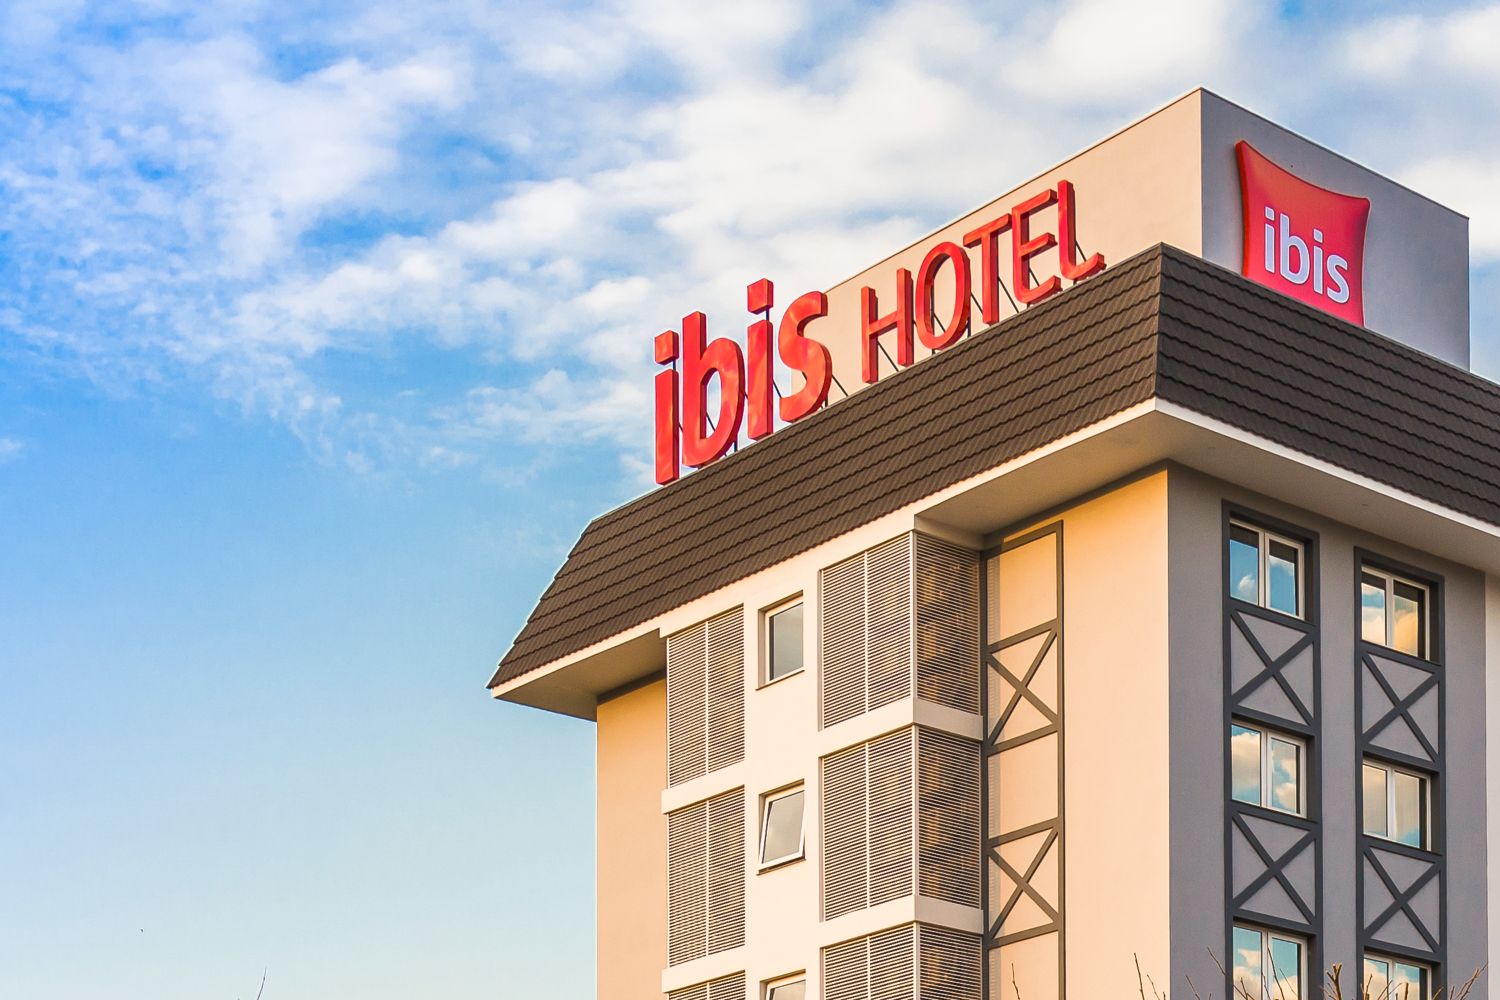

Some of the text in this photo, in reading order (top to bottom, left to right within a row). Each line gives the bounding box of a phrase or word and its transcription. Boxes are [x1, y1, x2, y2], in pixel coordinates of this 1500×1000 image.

[655, 179, 1106, 485] ibis HOTEL
[1265, 206, 1349, 304] ibis
